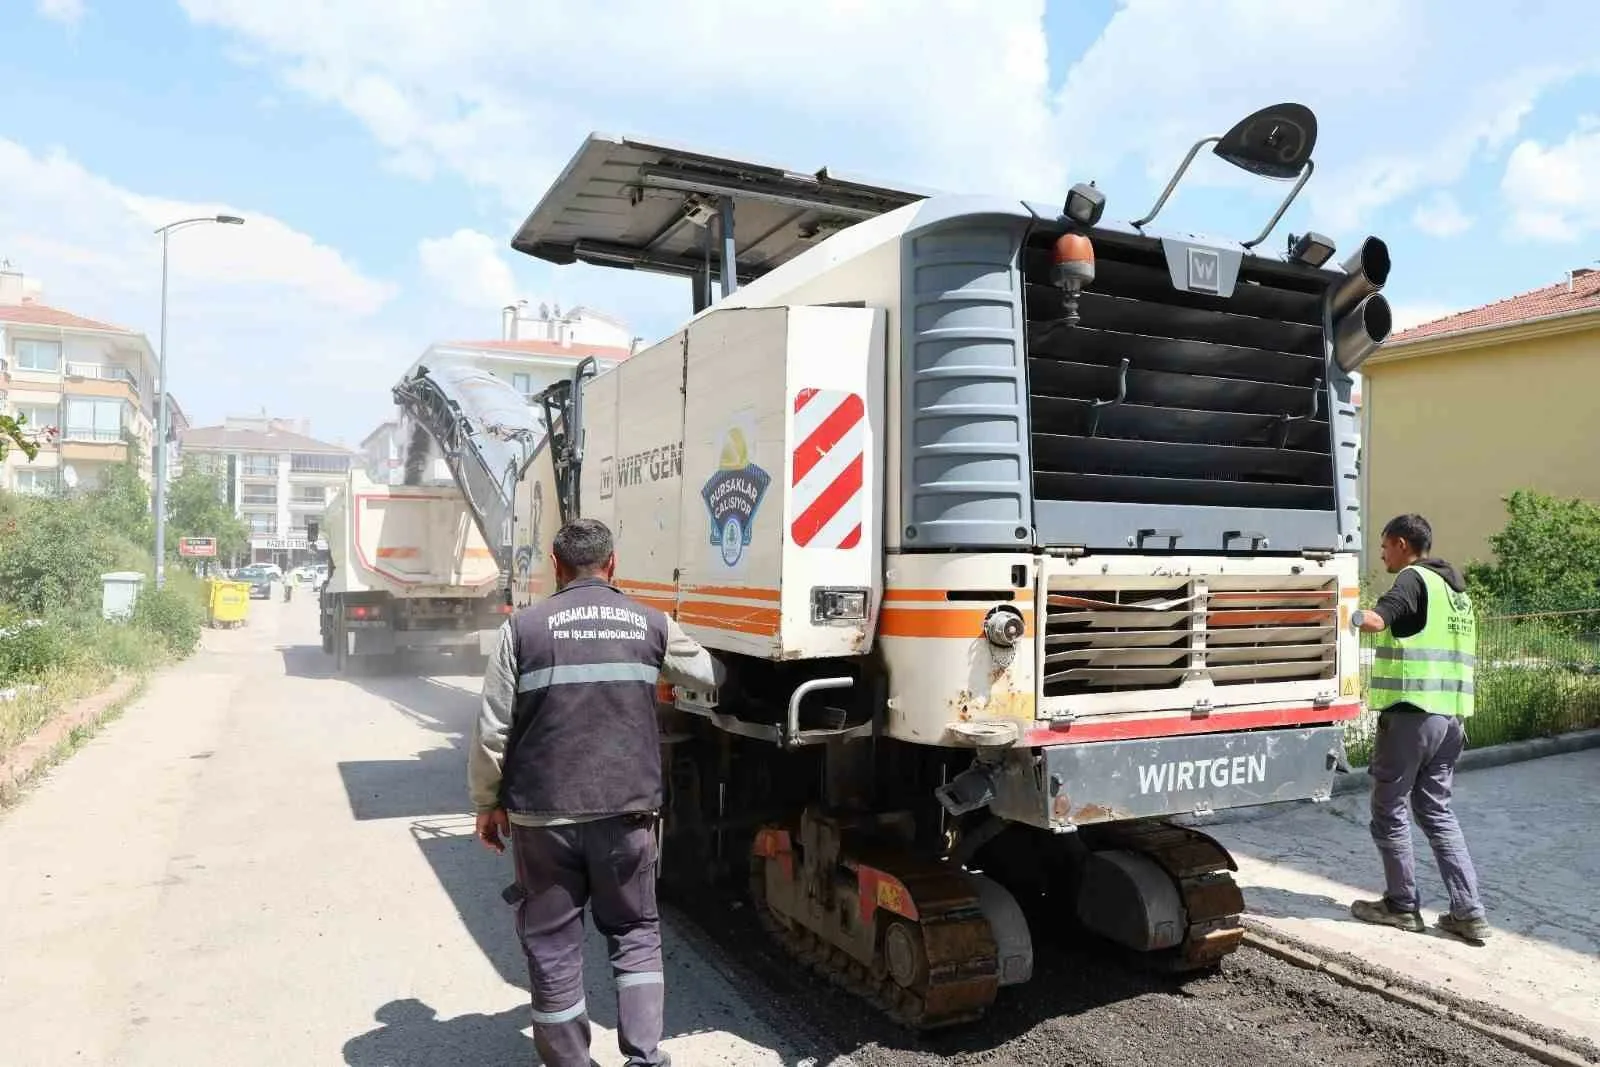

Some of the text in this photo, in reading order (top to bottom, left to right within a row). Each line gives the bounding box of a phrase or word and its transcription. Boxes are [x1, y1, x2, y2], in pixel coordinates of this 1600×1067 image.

[617, 441, 682, 489] WIRTGEN
[710, 478, 758, 508] PURSAKLAR
[715, 496, 752, 519] ÇALIŞIYOR
[548, 606, 648, 631] PURSAKLAR BELEDİYESİ
[553, 630, 570, 640] FEN
[1138, 754, 1267, 794] WIRTGEN
